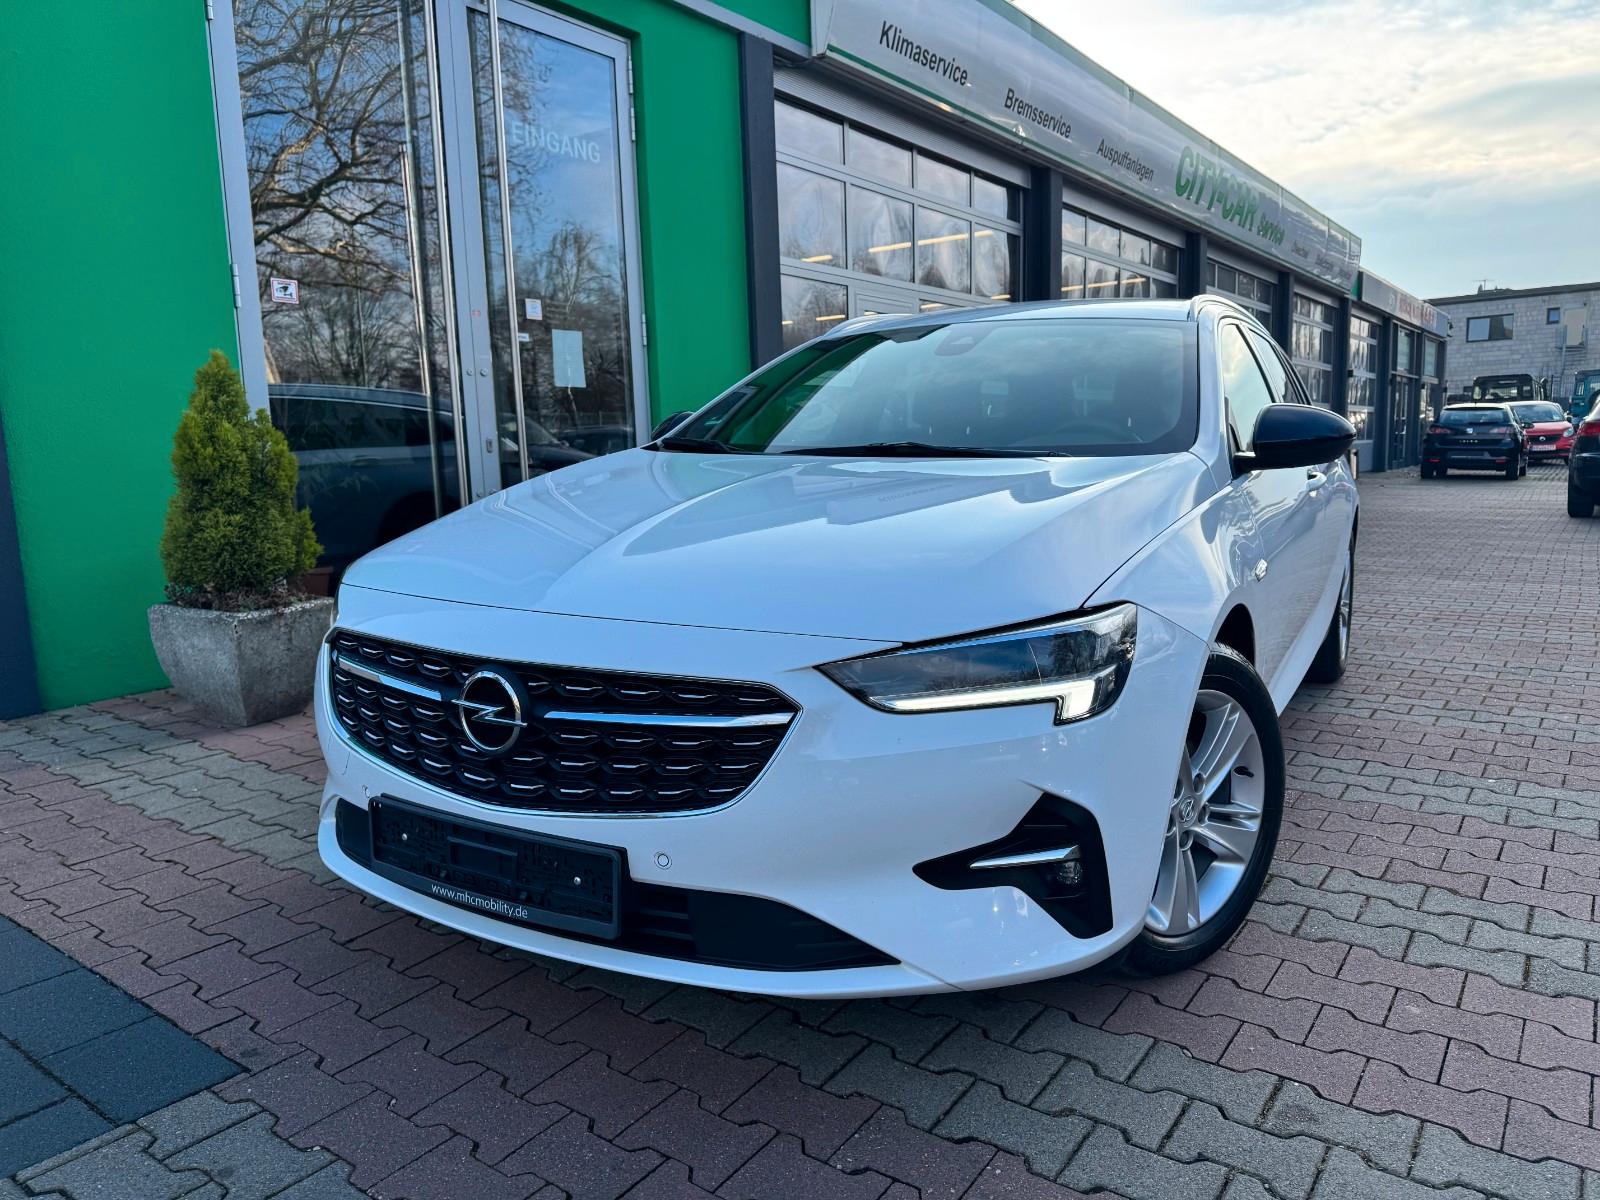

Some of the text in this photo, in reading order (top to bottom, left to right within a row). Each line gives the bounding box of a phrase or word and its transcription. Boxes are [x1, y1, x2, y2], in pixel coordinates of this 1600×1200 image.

[879, 20, 968, 87] Klimaservice
[1004, 88, 1071, 139] Bremsservice
[511, 120, 600, 164] EINGANG
[1097, 138, 1154, 182] Auspuffanlagen
[431, 884, 528, 919] www.mhcmobility.de
